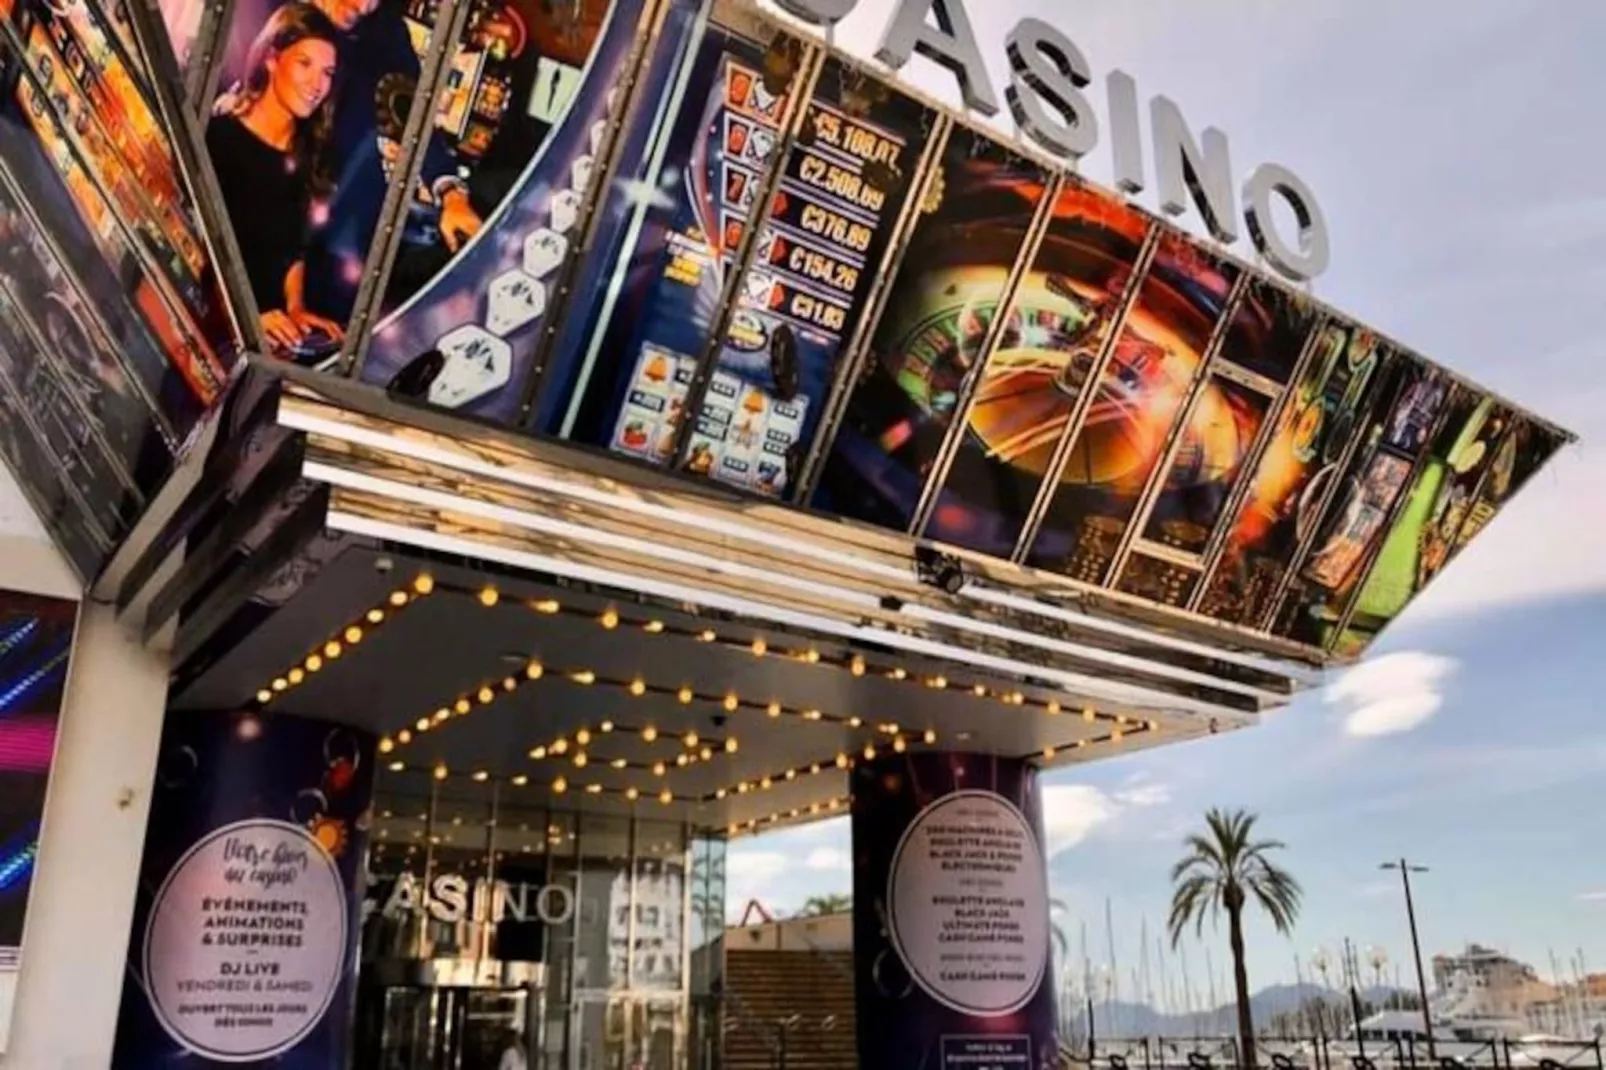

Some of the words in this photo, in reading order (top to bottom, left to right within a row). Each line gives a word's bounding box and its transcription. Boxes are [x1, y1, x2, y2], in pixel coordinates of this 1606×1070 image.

[768, 0, 1331, 282] ASINO
[203, 916, 305, 931] ANIMATIONS
[217, 932, 304, 948] SURPRISES
[220, 962, 242, 975] DJ
[244, 962, 280, 976] LIVE
